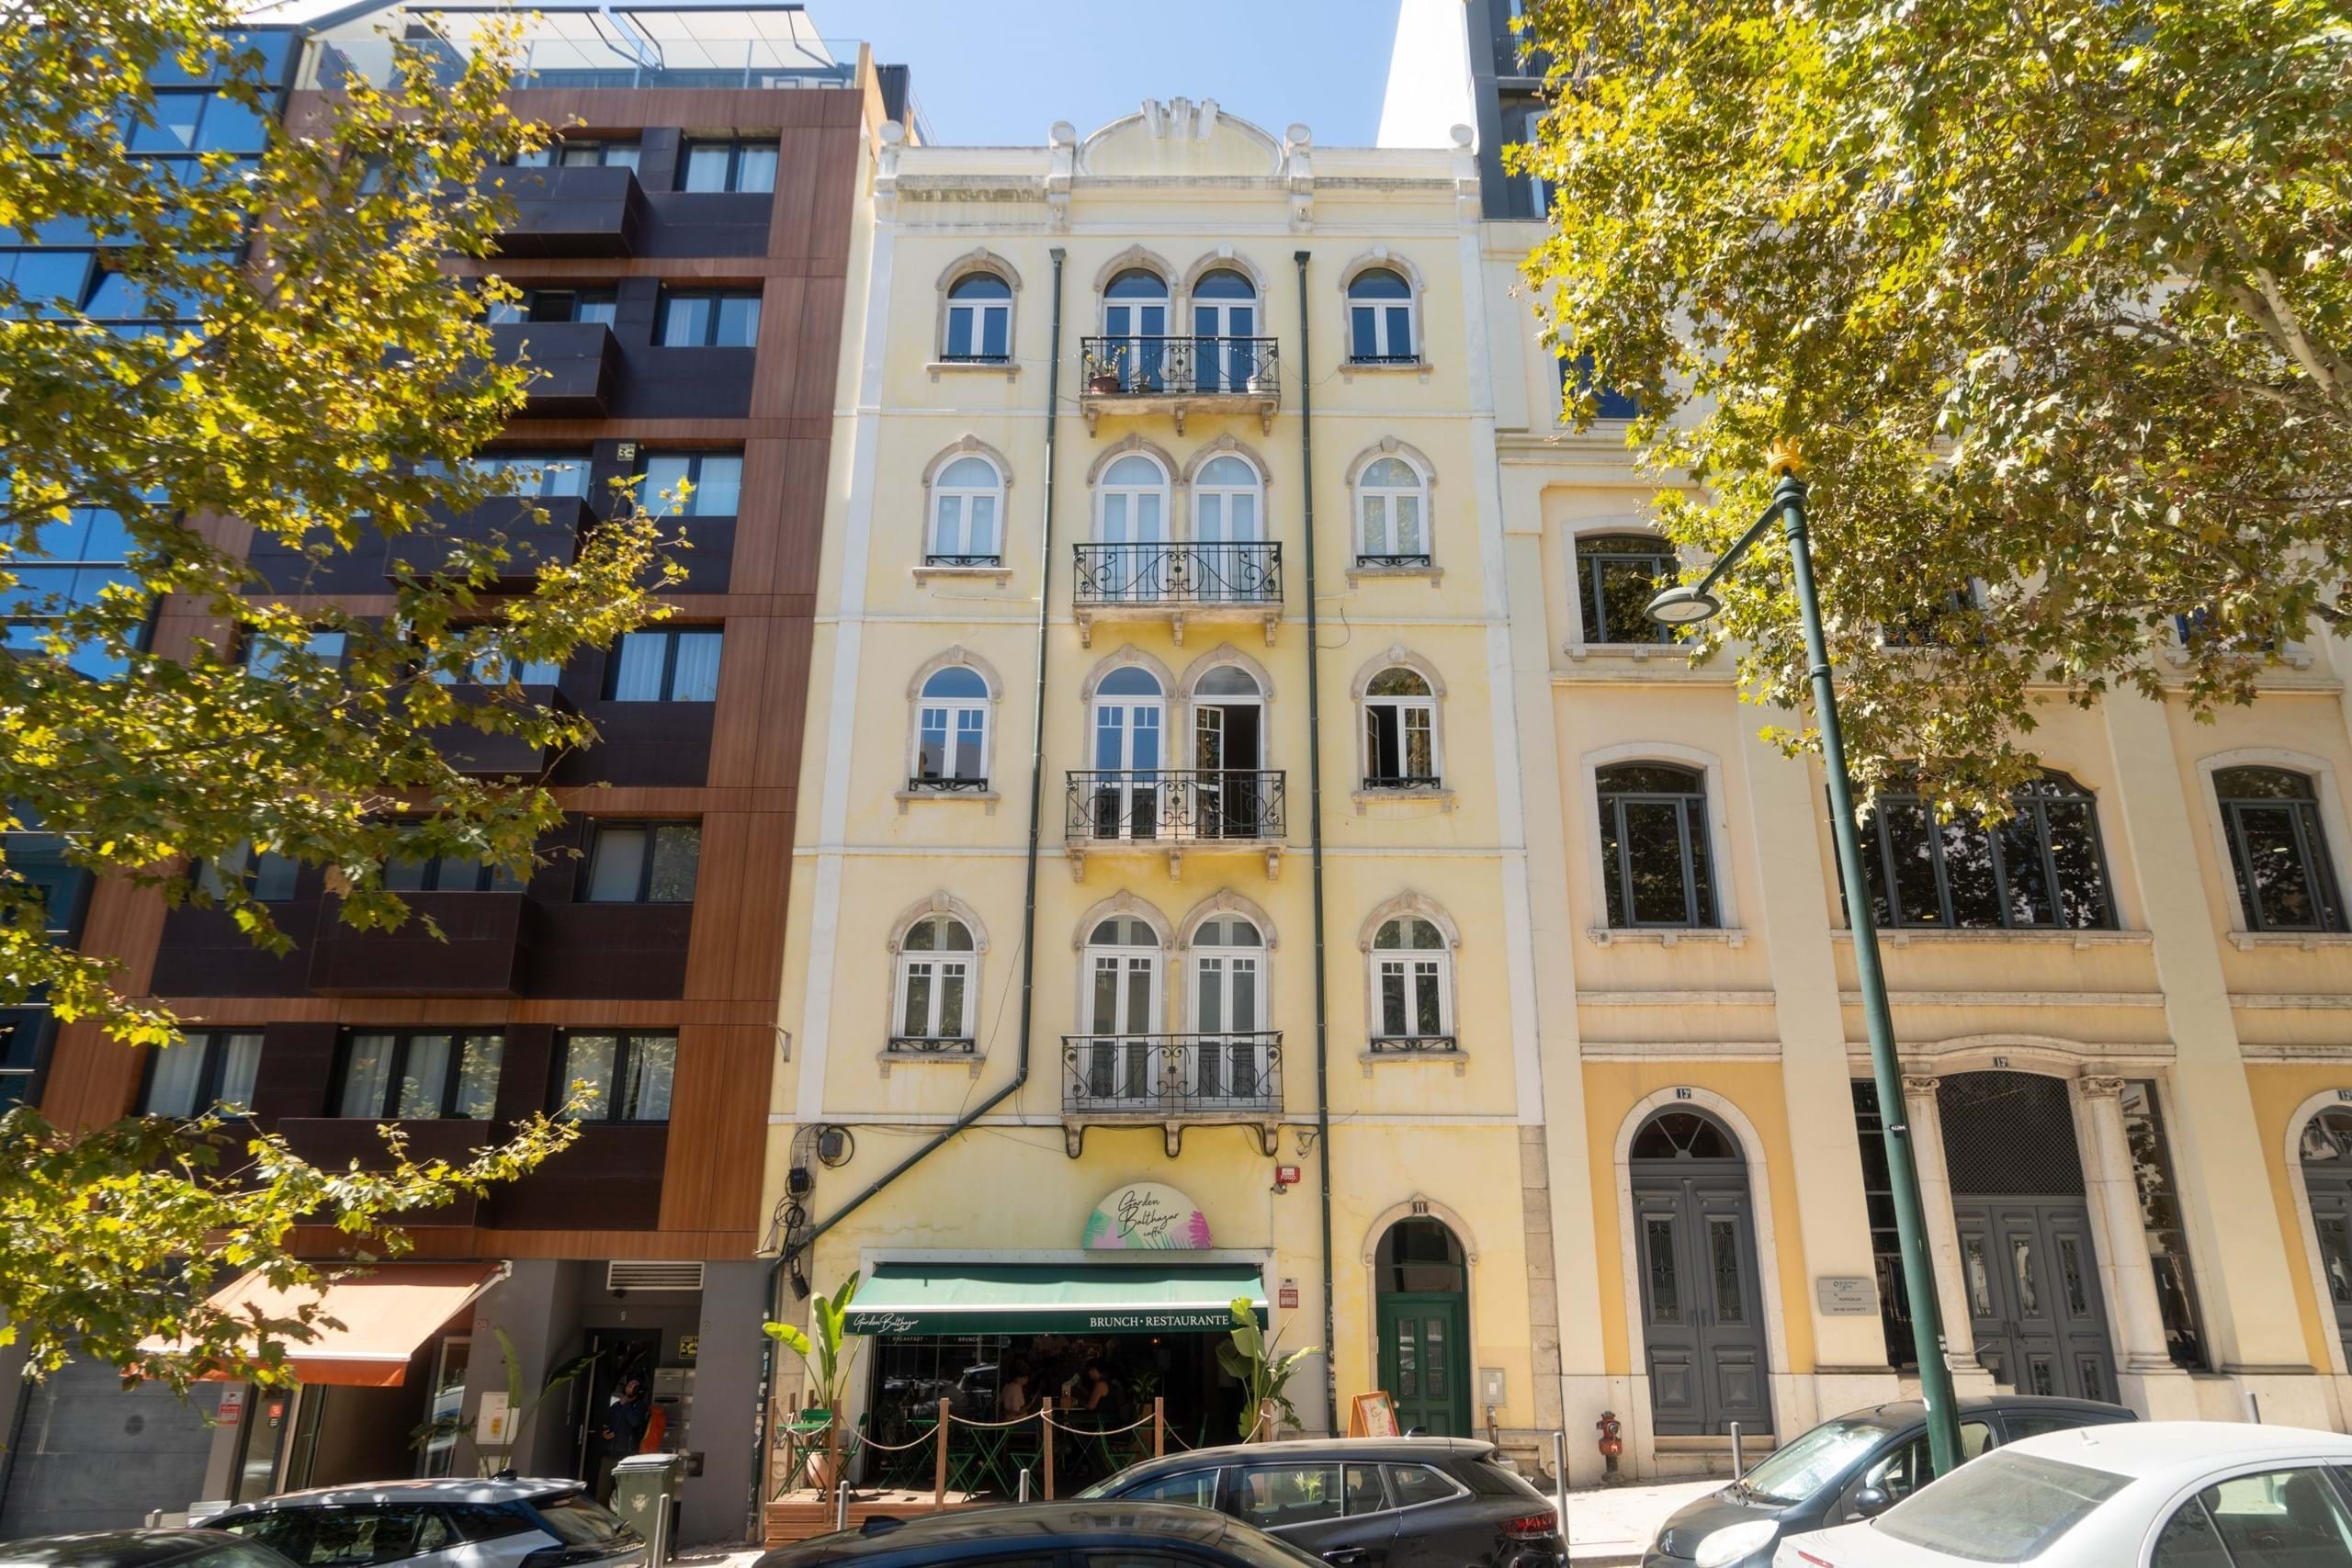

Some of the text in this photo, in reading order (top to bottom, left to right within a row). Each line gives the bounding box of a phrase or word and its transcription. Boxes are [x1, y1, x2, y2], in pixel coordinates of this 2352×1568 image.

[1118, 1190, 1160, 1212] Garden
[1090, 1314, 1229, 1327] BRUNCH RESTAURANTE
